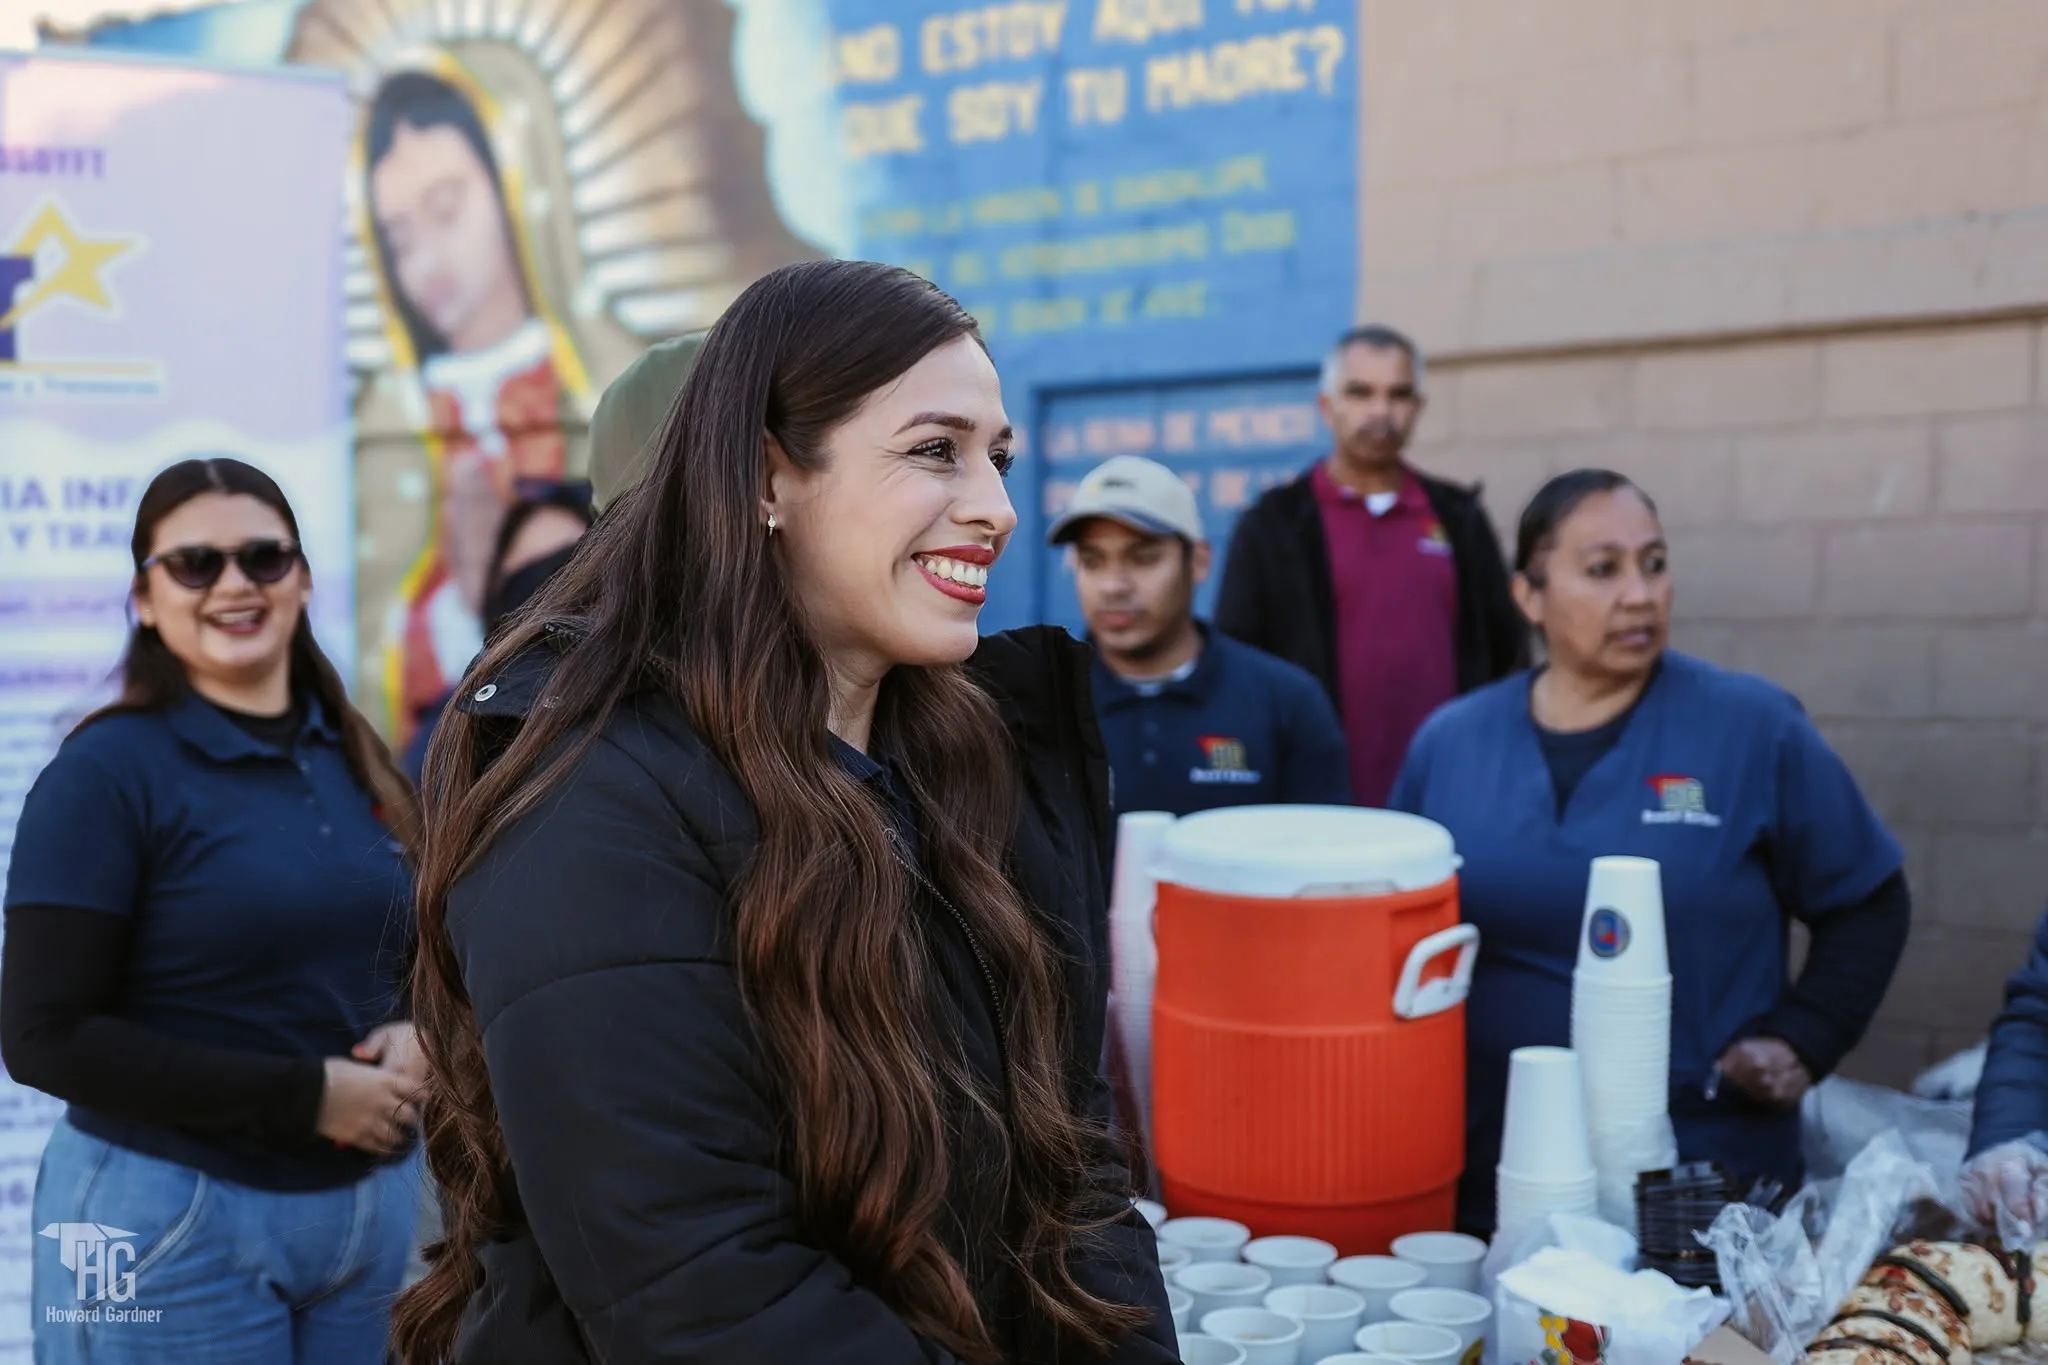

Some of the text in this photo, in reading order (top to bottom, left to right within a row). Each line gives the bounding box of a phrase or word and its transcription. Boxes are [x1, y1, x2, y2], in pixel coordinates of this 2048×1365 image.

[843, 22, 1346, 158] QUE SOY TU MADRE?
[920, 0, 1068, 76] ESTOY
